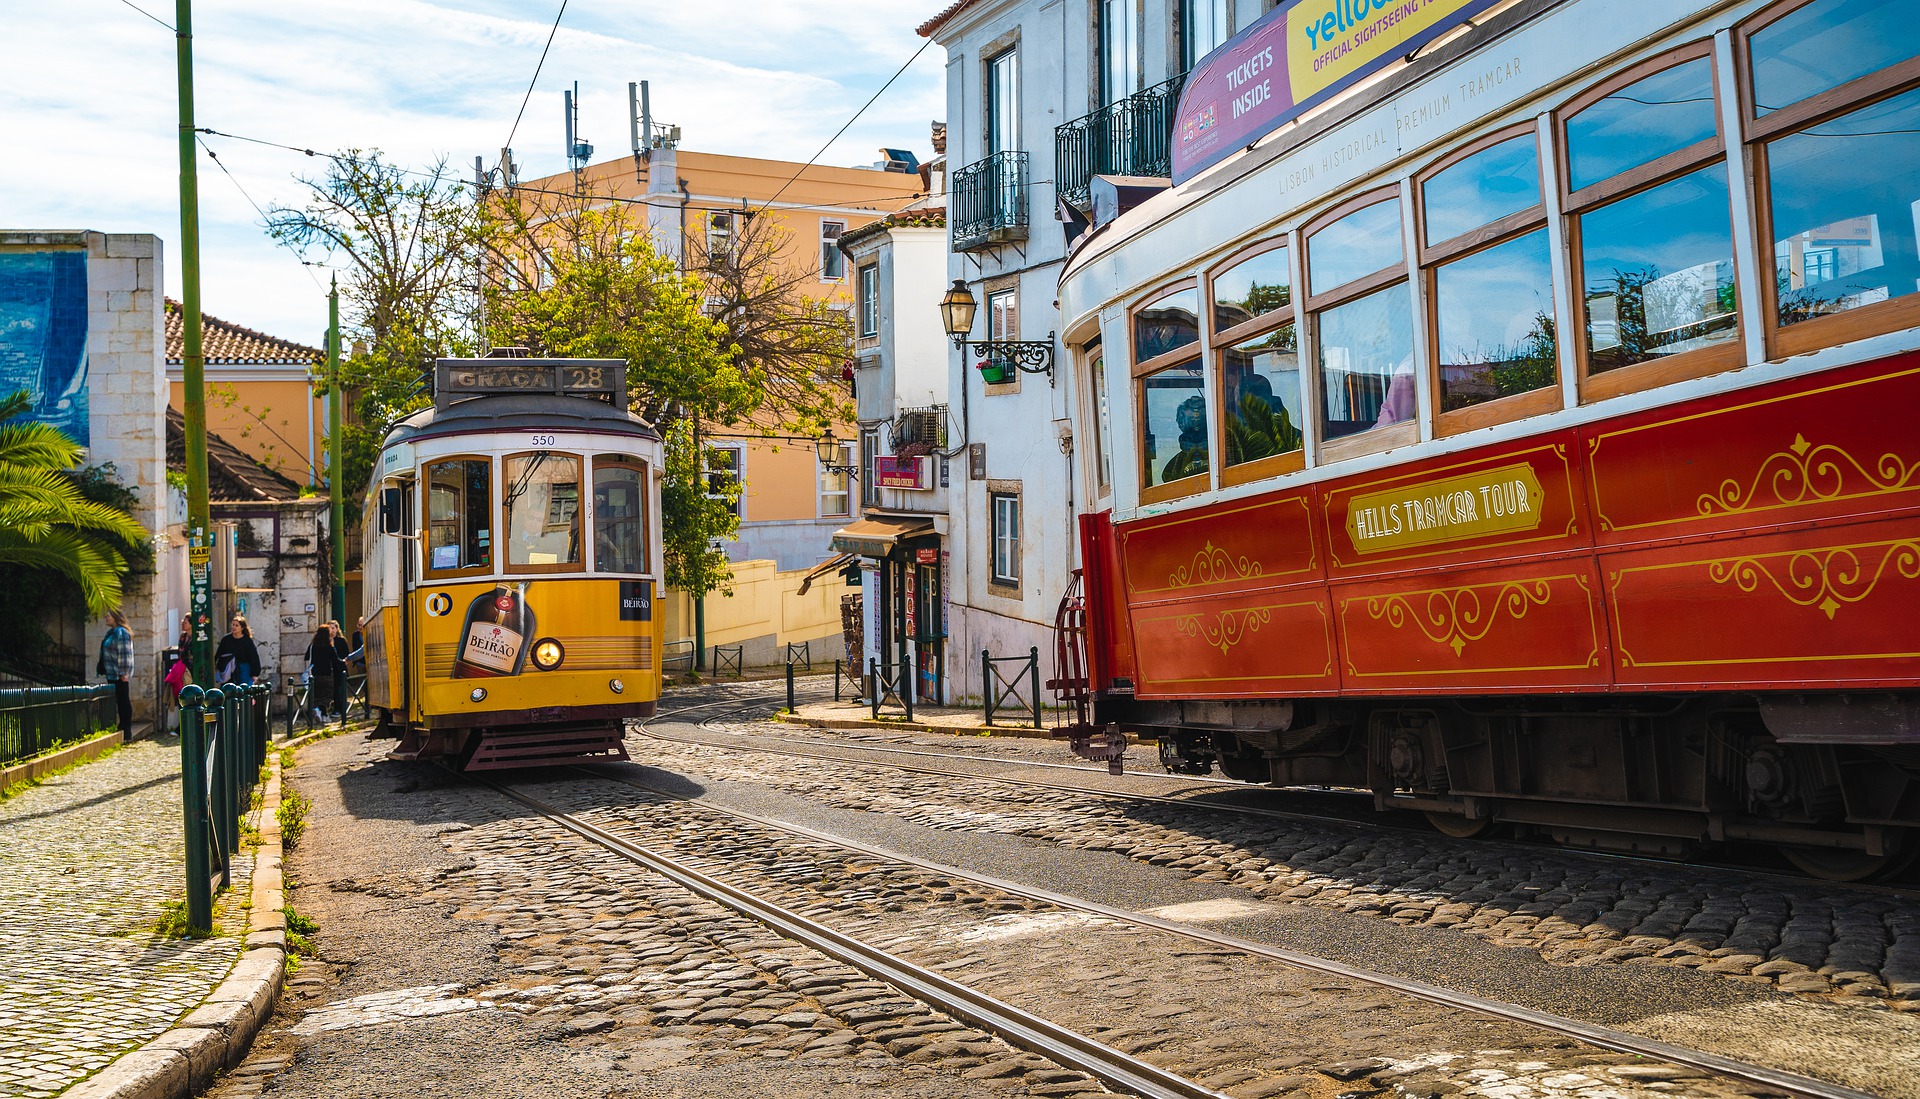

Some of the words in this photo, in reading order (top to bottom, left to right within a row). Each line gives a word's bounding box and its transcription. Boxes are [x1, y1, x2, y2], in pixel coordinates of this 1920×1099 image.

[1313, 39, 1352, 72] OFFICIAL
[1354, 0, 1418, 48] SIGHTSEEING
[1226, 46, 1273, 91] TICKETS
[1232, 79, 1271, 119] INSIDE
[1278, 163, 1315, 195] LISBON
[1322, 128, 1387, 173] HISTORICAL
[1396, 93, 1451, 133] PREMIUM
[1460, 57, 1522, 102] TRAMCAR
[572, 369, 603, 388] 28
[532, 435, 555, 446] 550
[1355, 503, 1402, 540] HILLS
[1404, 490, 1478, 531] TRAMCAR
[1479, 480, 1531, 519] TOUR
[470, 635, 515, 658] BEIRÃO
